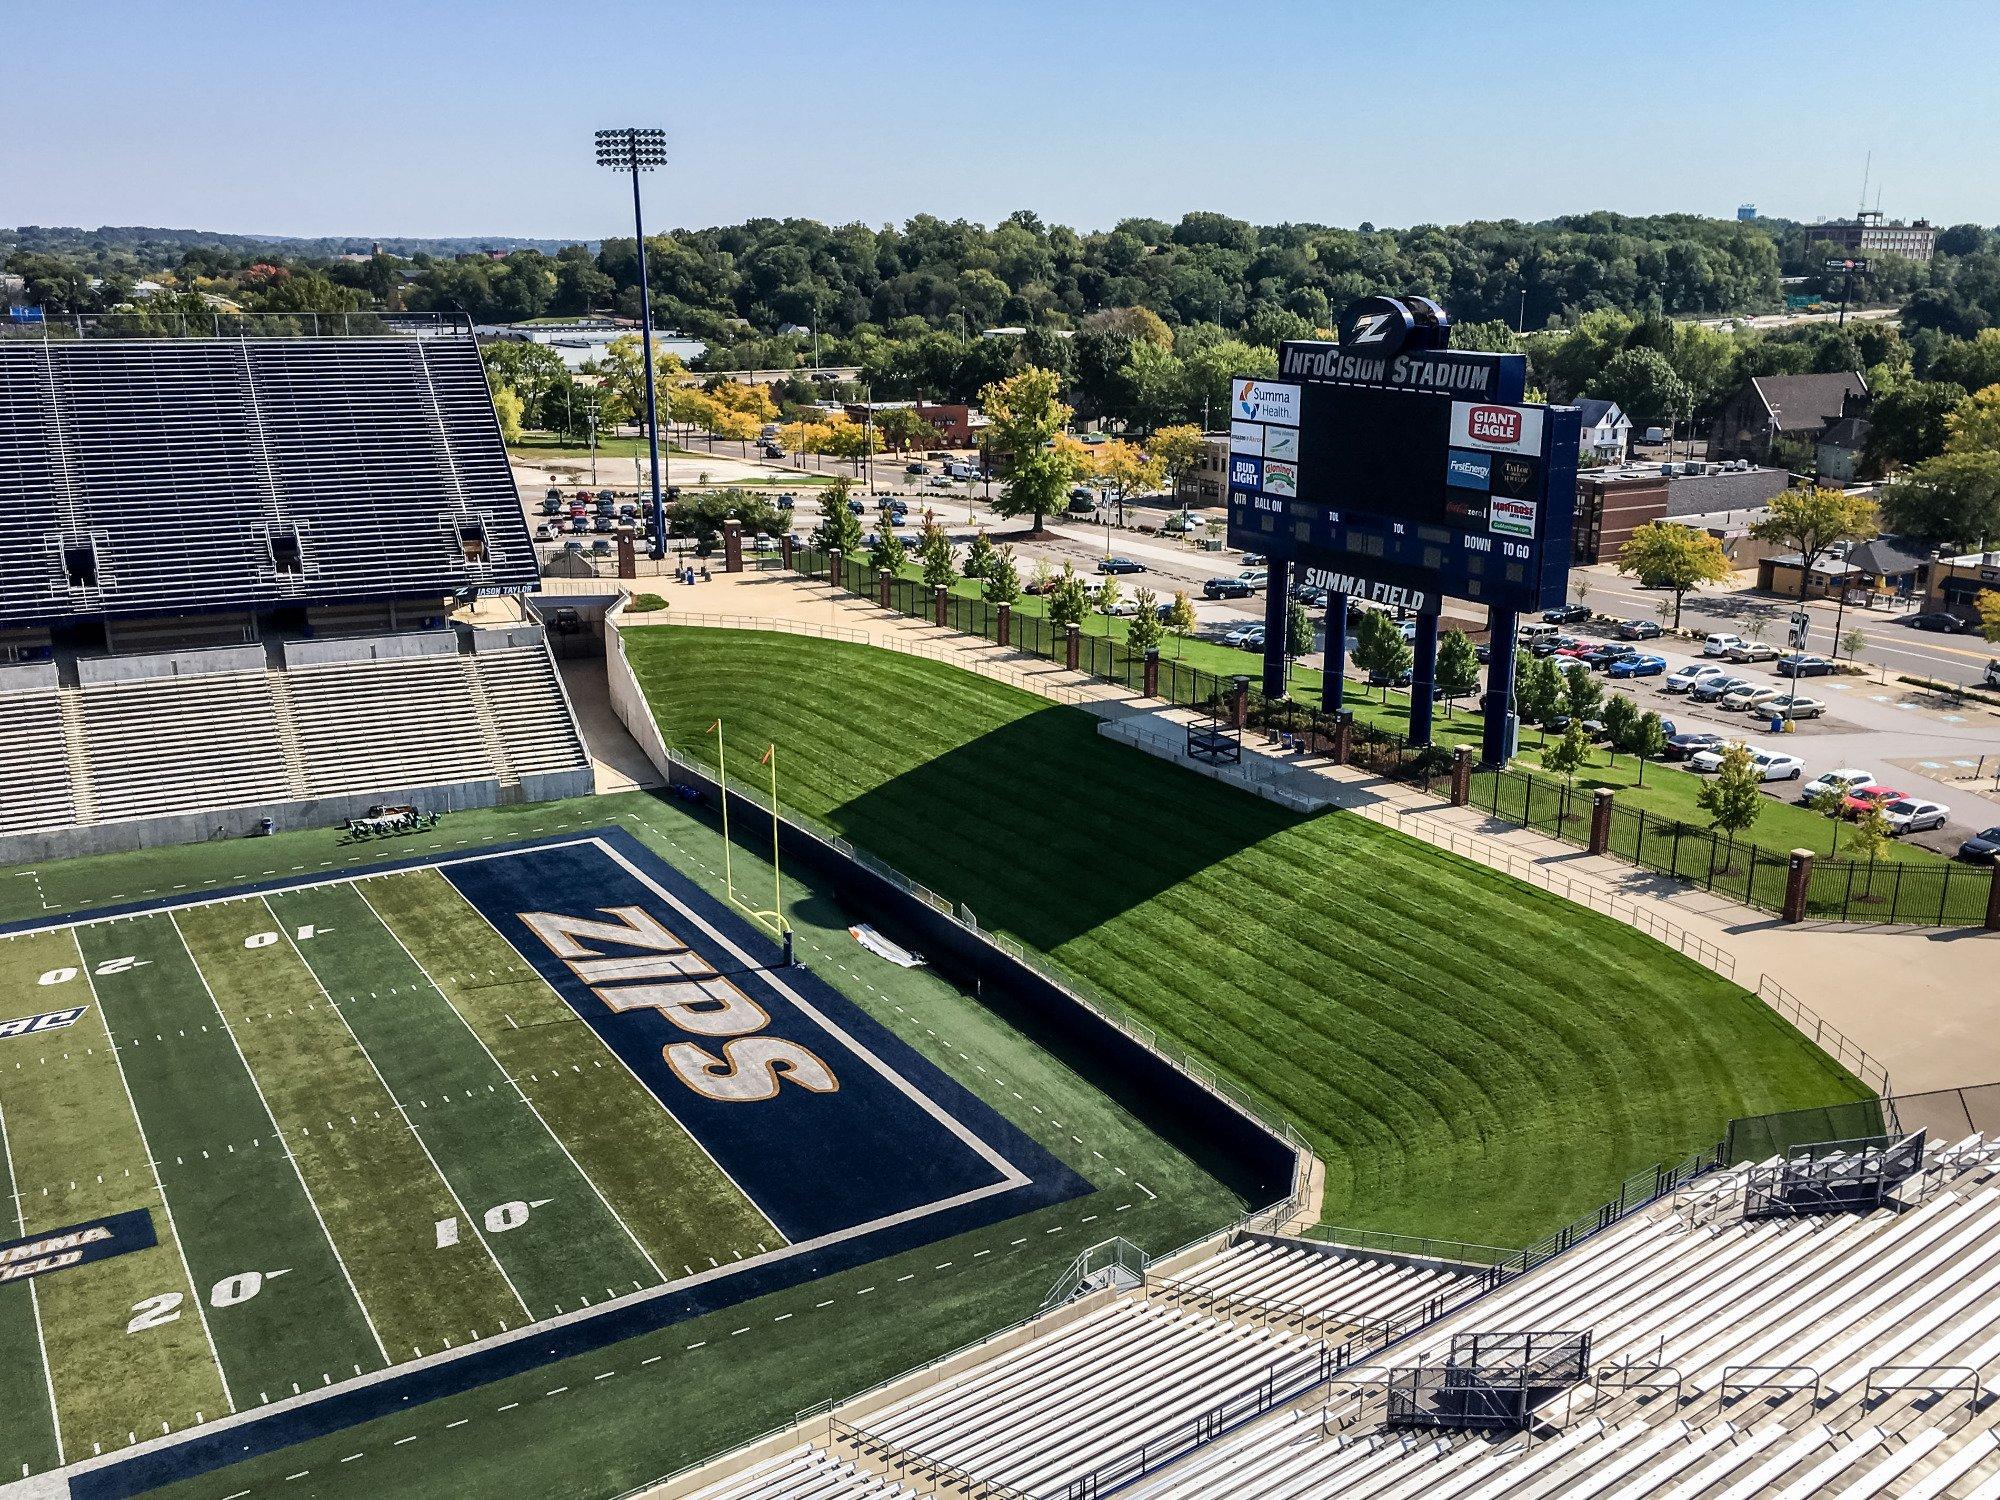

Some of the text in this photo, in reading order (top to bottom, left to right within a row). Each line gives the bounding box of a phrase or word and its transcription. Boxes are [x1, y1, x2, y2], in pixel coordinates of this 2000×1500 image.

[1253, 387, 1290, 404] Summa
[1262, 404, 1290, 419] Health
[1473, 411, 1517, 426] GIANT
[1473, 423, 1515, 438] EAGLE
[1236, 461, 1255, 474] BUD
[1450, 460, 1489, 475] FirstEnergy
[1232, 471, 1259, 485] LIGHT
[1234, 492, 1247, 505] QTR
[1254, 496, 1270, 511] BALL
[1272, 500, 1282, 513] ON
[1467, 509, 1482, 517] zero
[1464, 534, 1491, 552] DOWN
[1503, 542, 1529, 559] TO GO
[477, 585, 532, 595] JASON TAYLOR
[1305, 567, 1425, 611] SUMMA FIELD
[516, 905, 839, 1101] ZIPS
